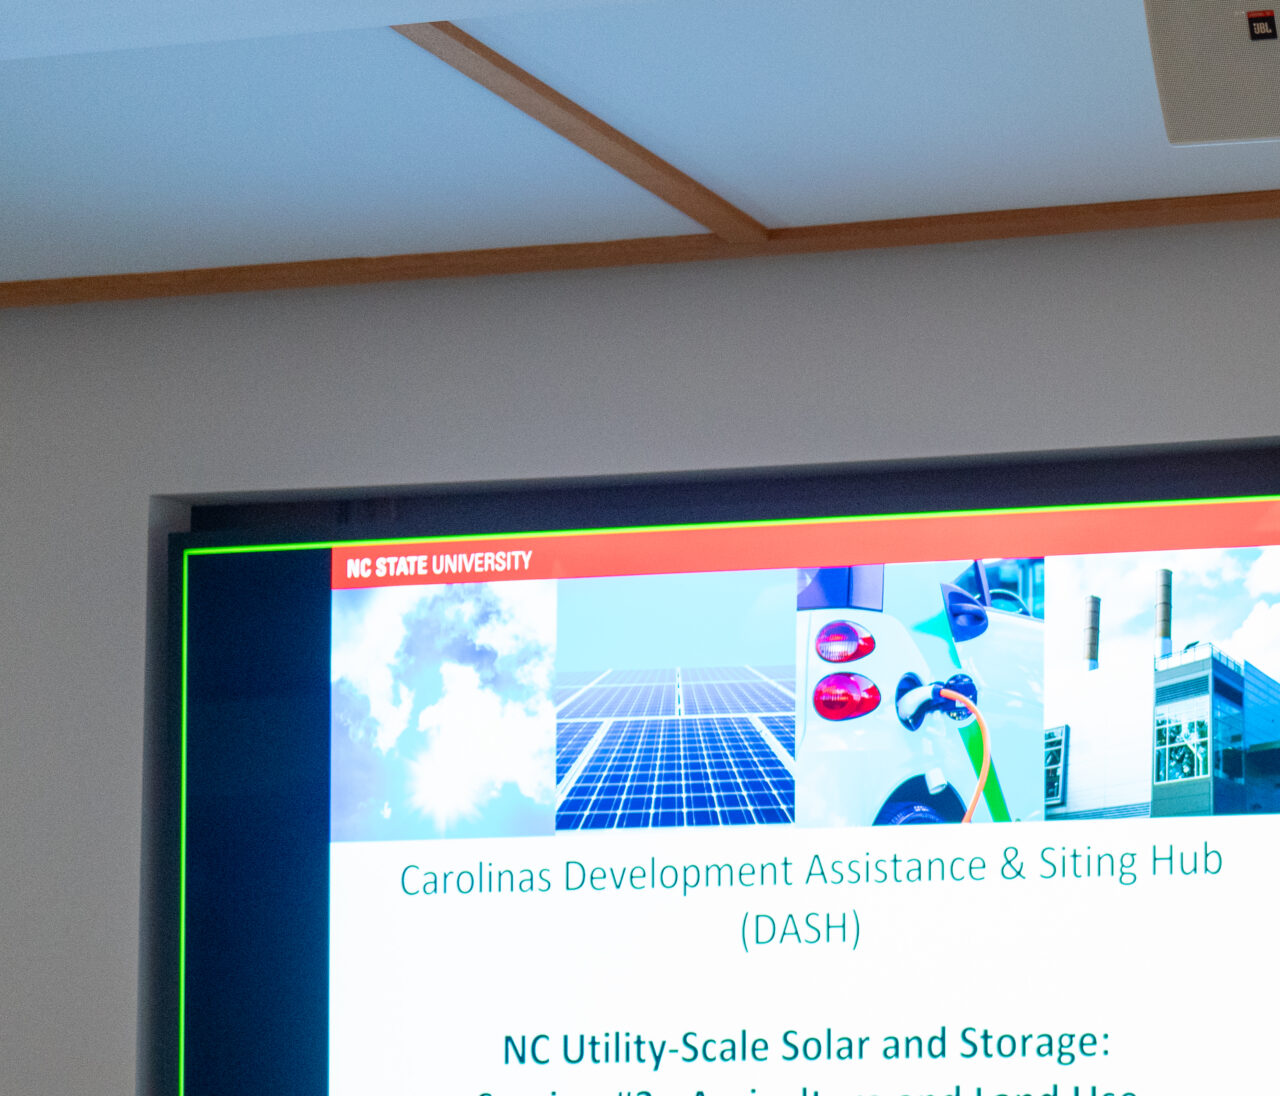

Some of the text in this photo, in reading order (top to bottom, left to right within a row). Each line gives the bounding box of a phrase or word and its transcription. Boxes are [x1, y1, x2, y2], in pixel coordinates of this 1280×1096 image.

[1253, 22, 1272, 35] JBL
[347, 551, 533, 579] NC STATE UNIVERSITY
[401, 841, 1222, 896] Carolinas Development Assistance & Siting Hub
[742, 910, 859, 952] (DASH)
[505, 1026, 1108, 1071] NC Utility-Scale Solar and Storage:
